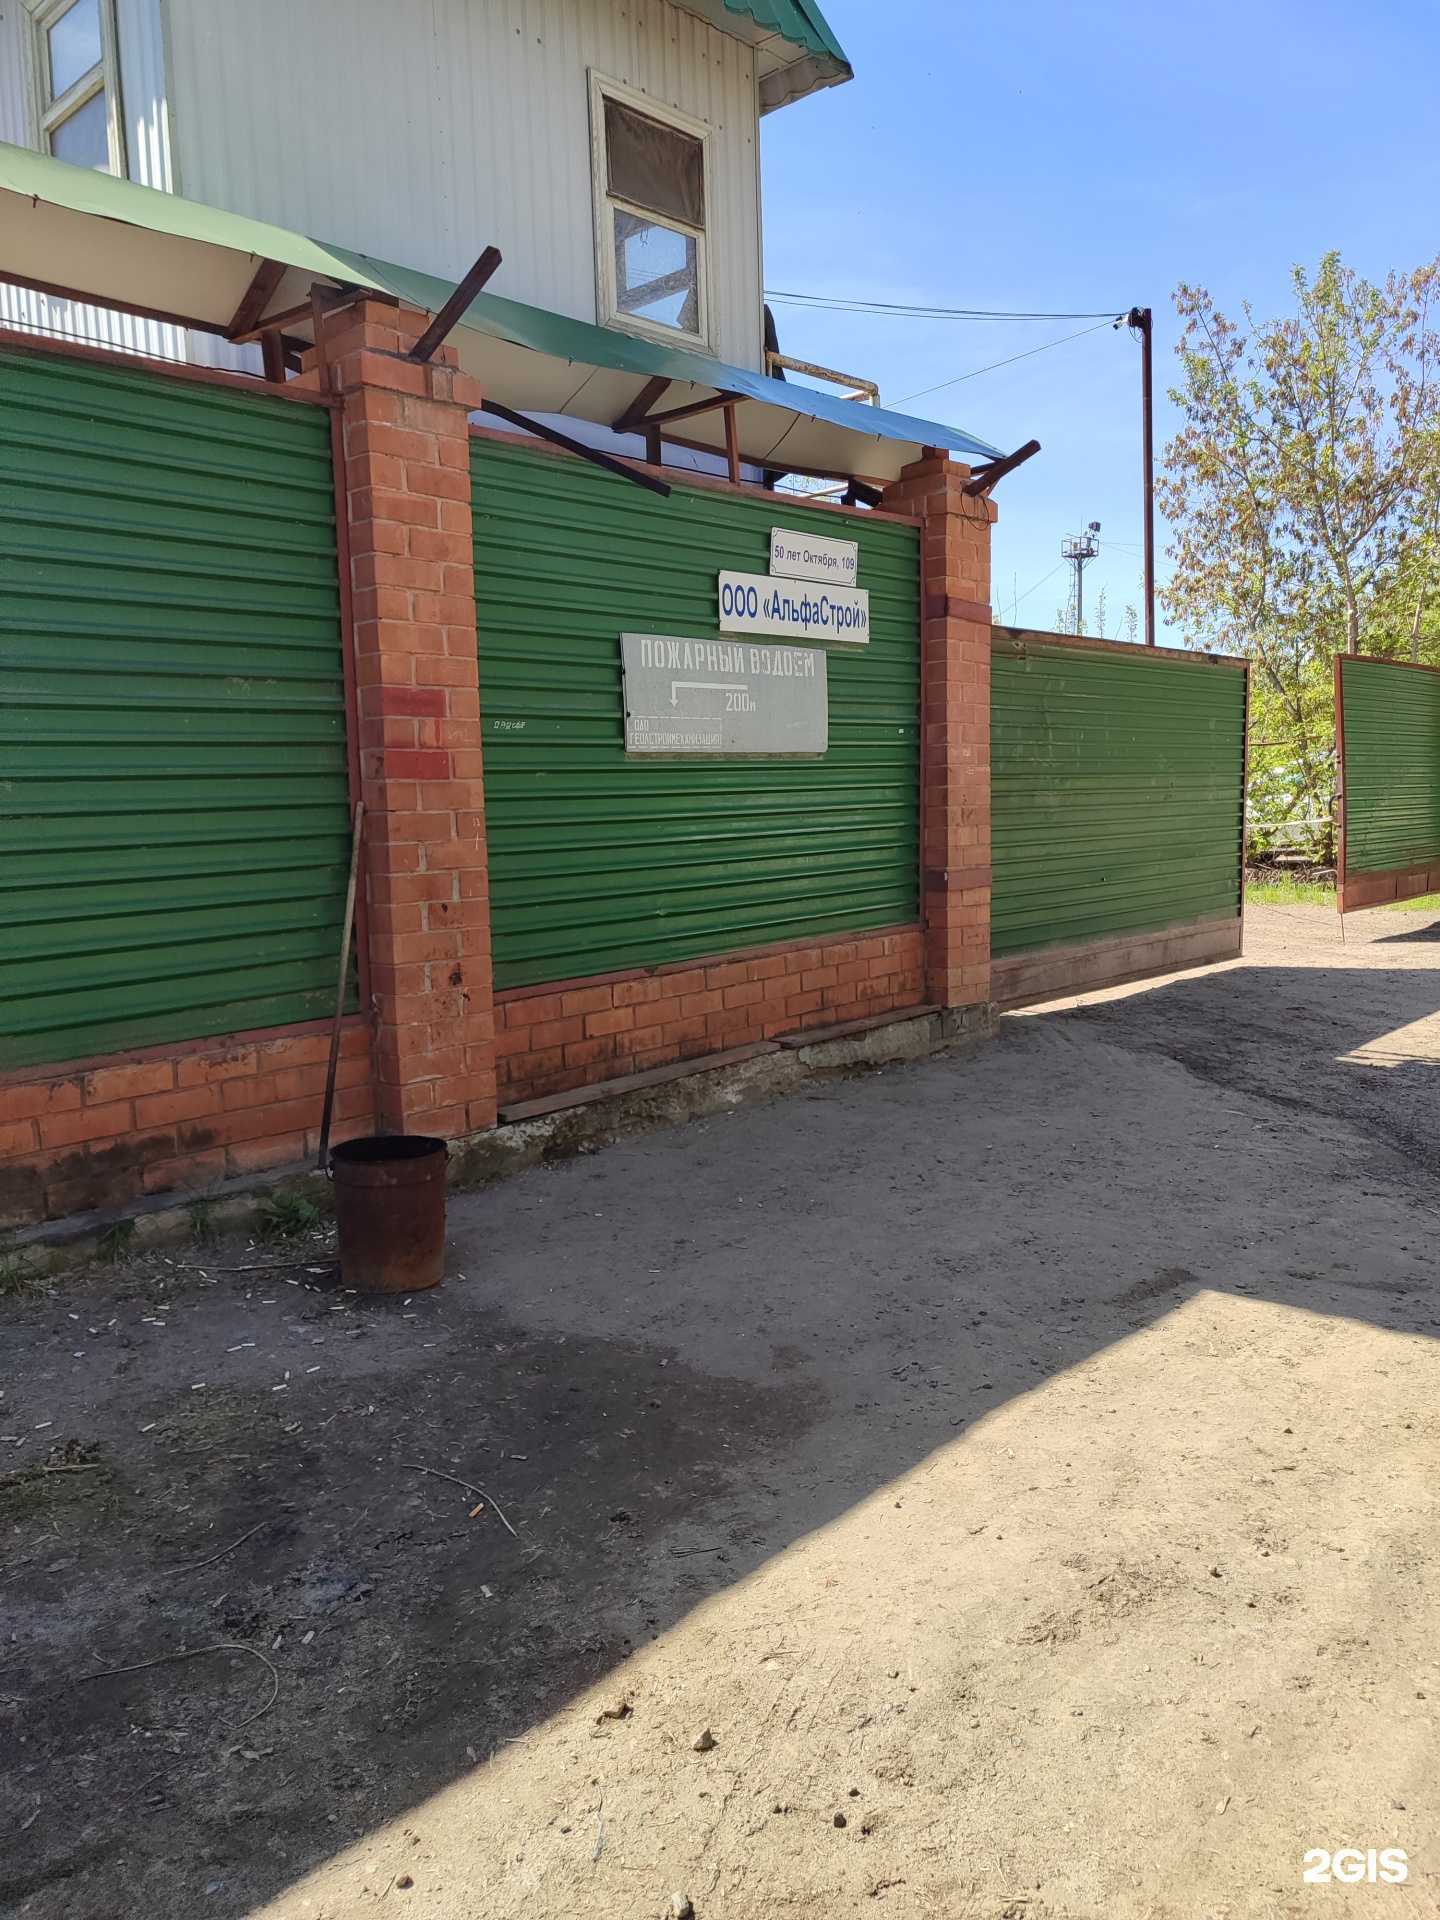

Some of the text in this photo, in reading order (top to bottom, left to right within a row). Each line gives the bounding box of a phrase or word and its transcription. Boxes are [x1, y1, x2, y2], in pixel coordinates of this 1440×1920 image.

[774, 545, 785, 558] 50
[786, 550, 801, 561] лет
[842, 557, 855, 570] 109
[722, 583, 867, 634] ООО «АльфаСтрой»
[640, 639, 745, 673] ПОЖАРНЫЙ
